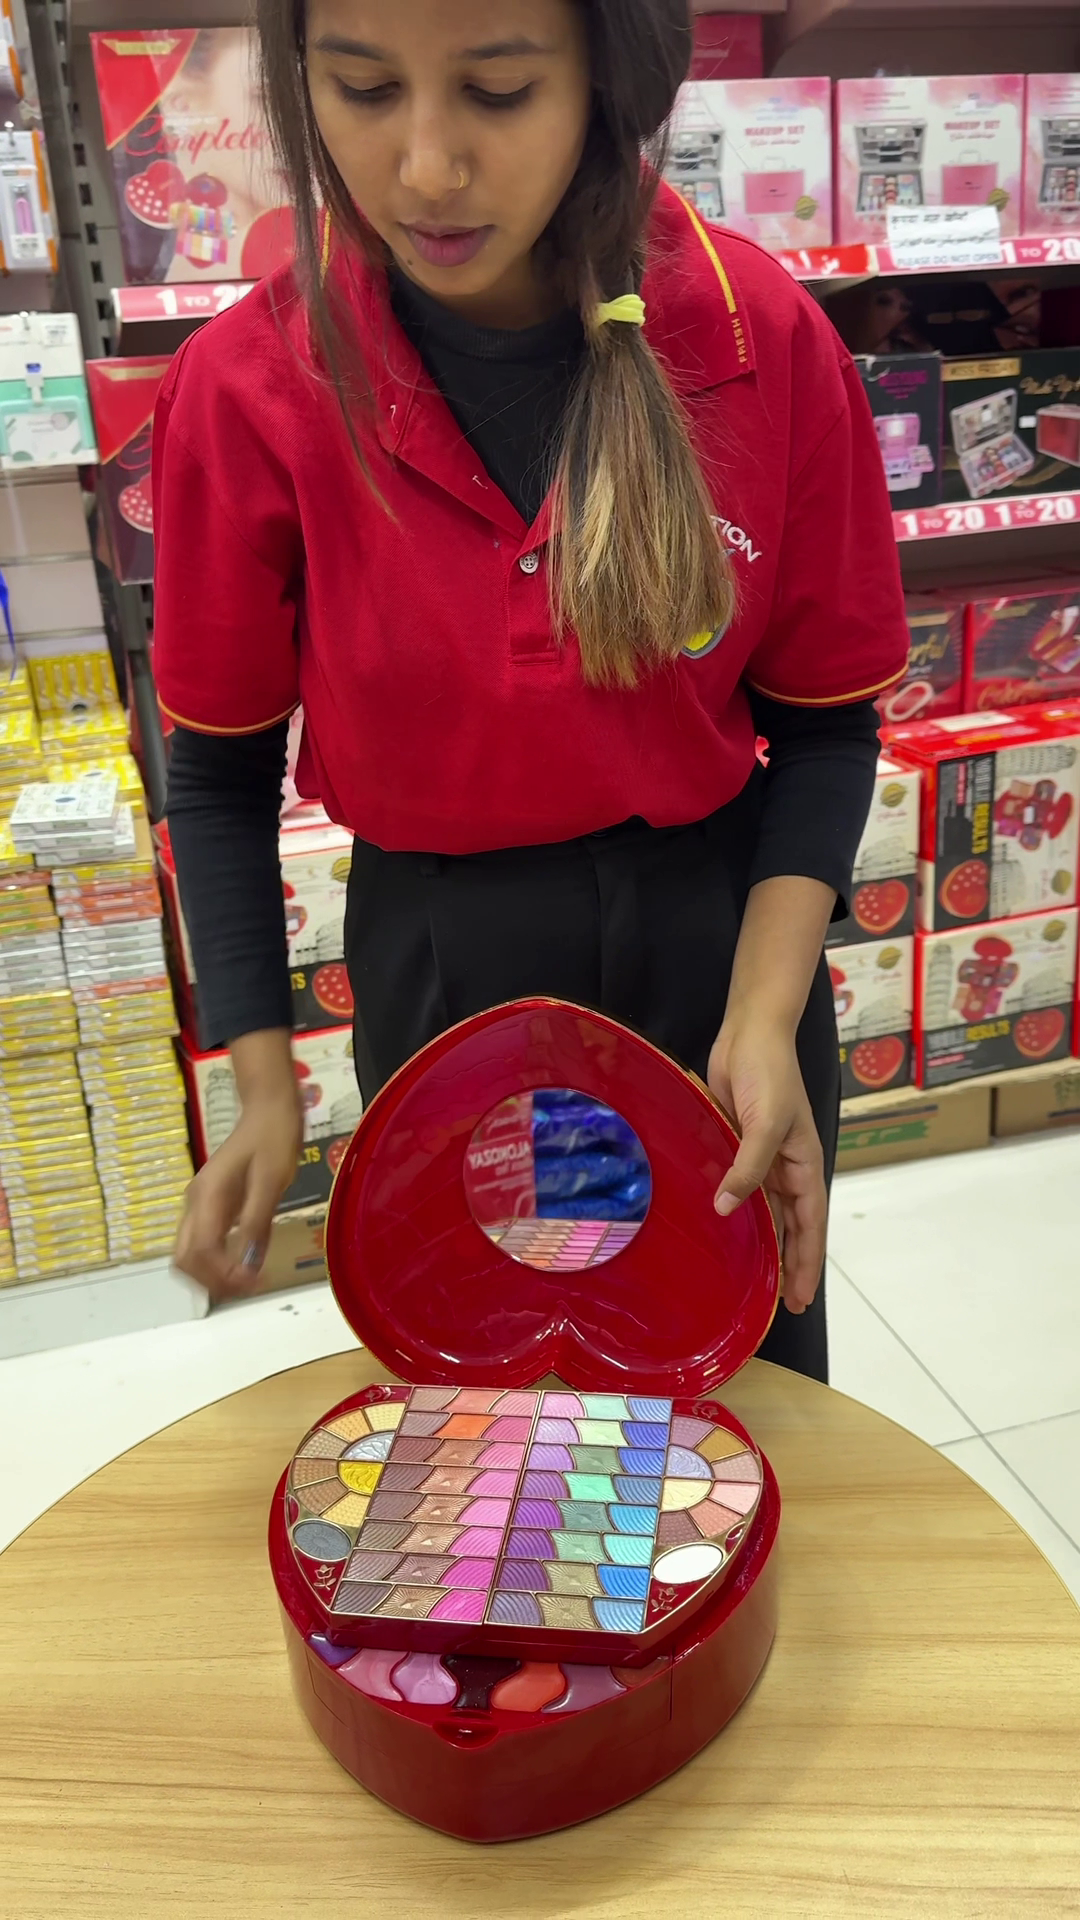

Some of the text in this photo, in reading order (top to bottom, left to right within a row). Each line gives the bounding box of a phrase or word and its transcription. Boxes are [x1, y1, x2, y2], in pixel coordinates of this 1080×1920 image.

[1001, 238, 1080, 264] 1 TO 20
[156, 287, 178, 316] 1
[183, 295, 211, 308] TO
[731, 318, 748, 363] FRESH
[901, 507, 985, 537] 1 TO 20
[995, 497, 1076, 527] 1 TO 20
[709, 514, 763, 562] TION
